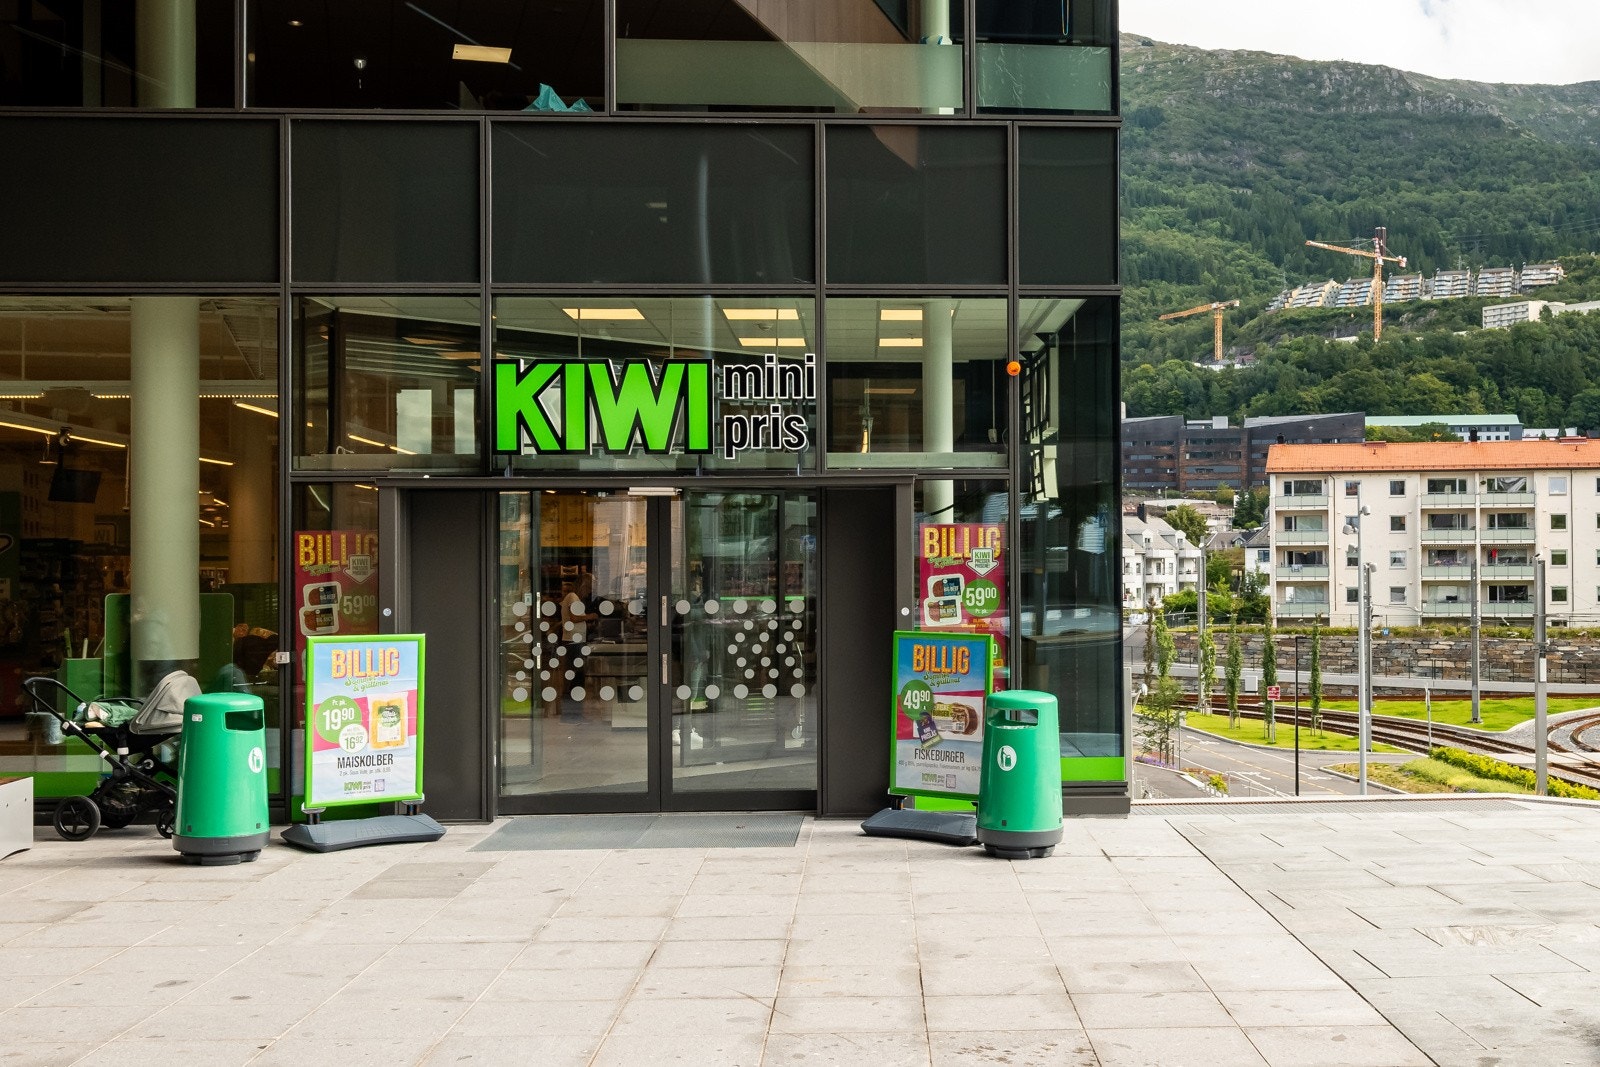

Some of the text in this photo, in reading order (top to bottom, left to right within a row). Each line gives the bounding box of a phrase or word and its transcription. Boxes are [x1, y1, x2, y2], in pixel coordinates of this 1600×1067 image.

[493, 353, 816, 454] KIWI mini
[723, 404, 807, 459] pris
[924, 527, 1001, 560] BILLIG
[975, 551, 991, 559] KIWI
[331, 647, 400, 678] BILLIG
[913, 645, 970, 674] BILLIG
[337, 753, 394, 770] MAISKOLBER
[913, 748, 965, 764] FISKEBURGER
[343, 781, 363, 792] KIWI
